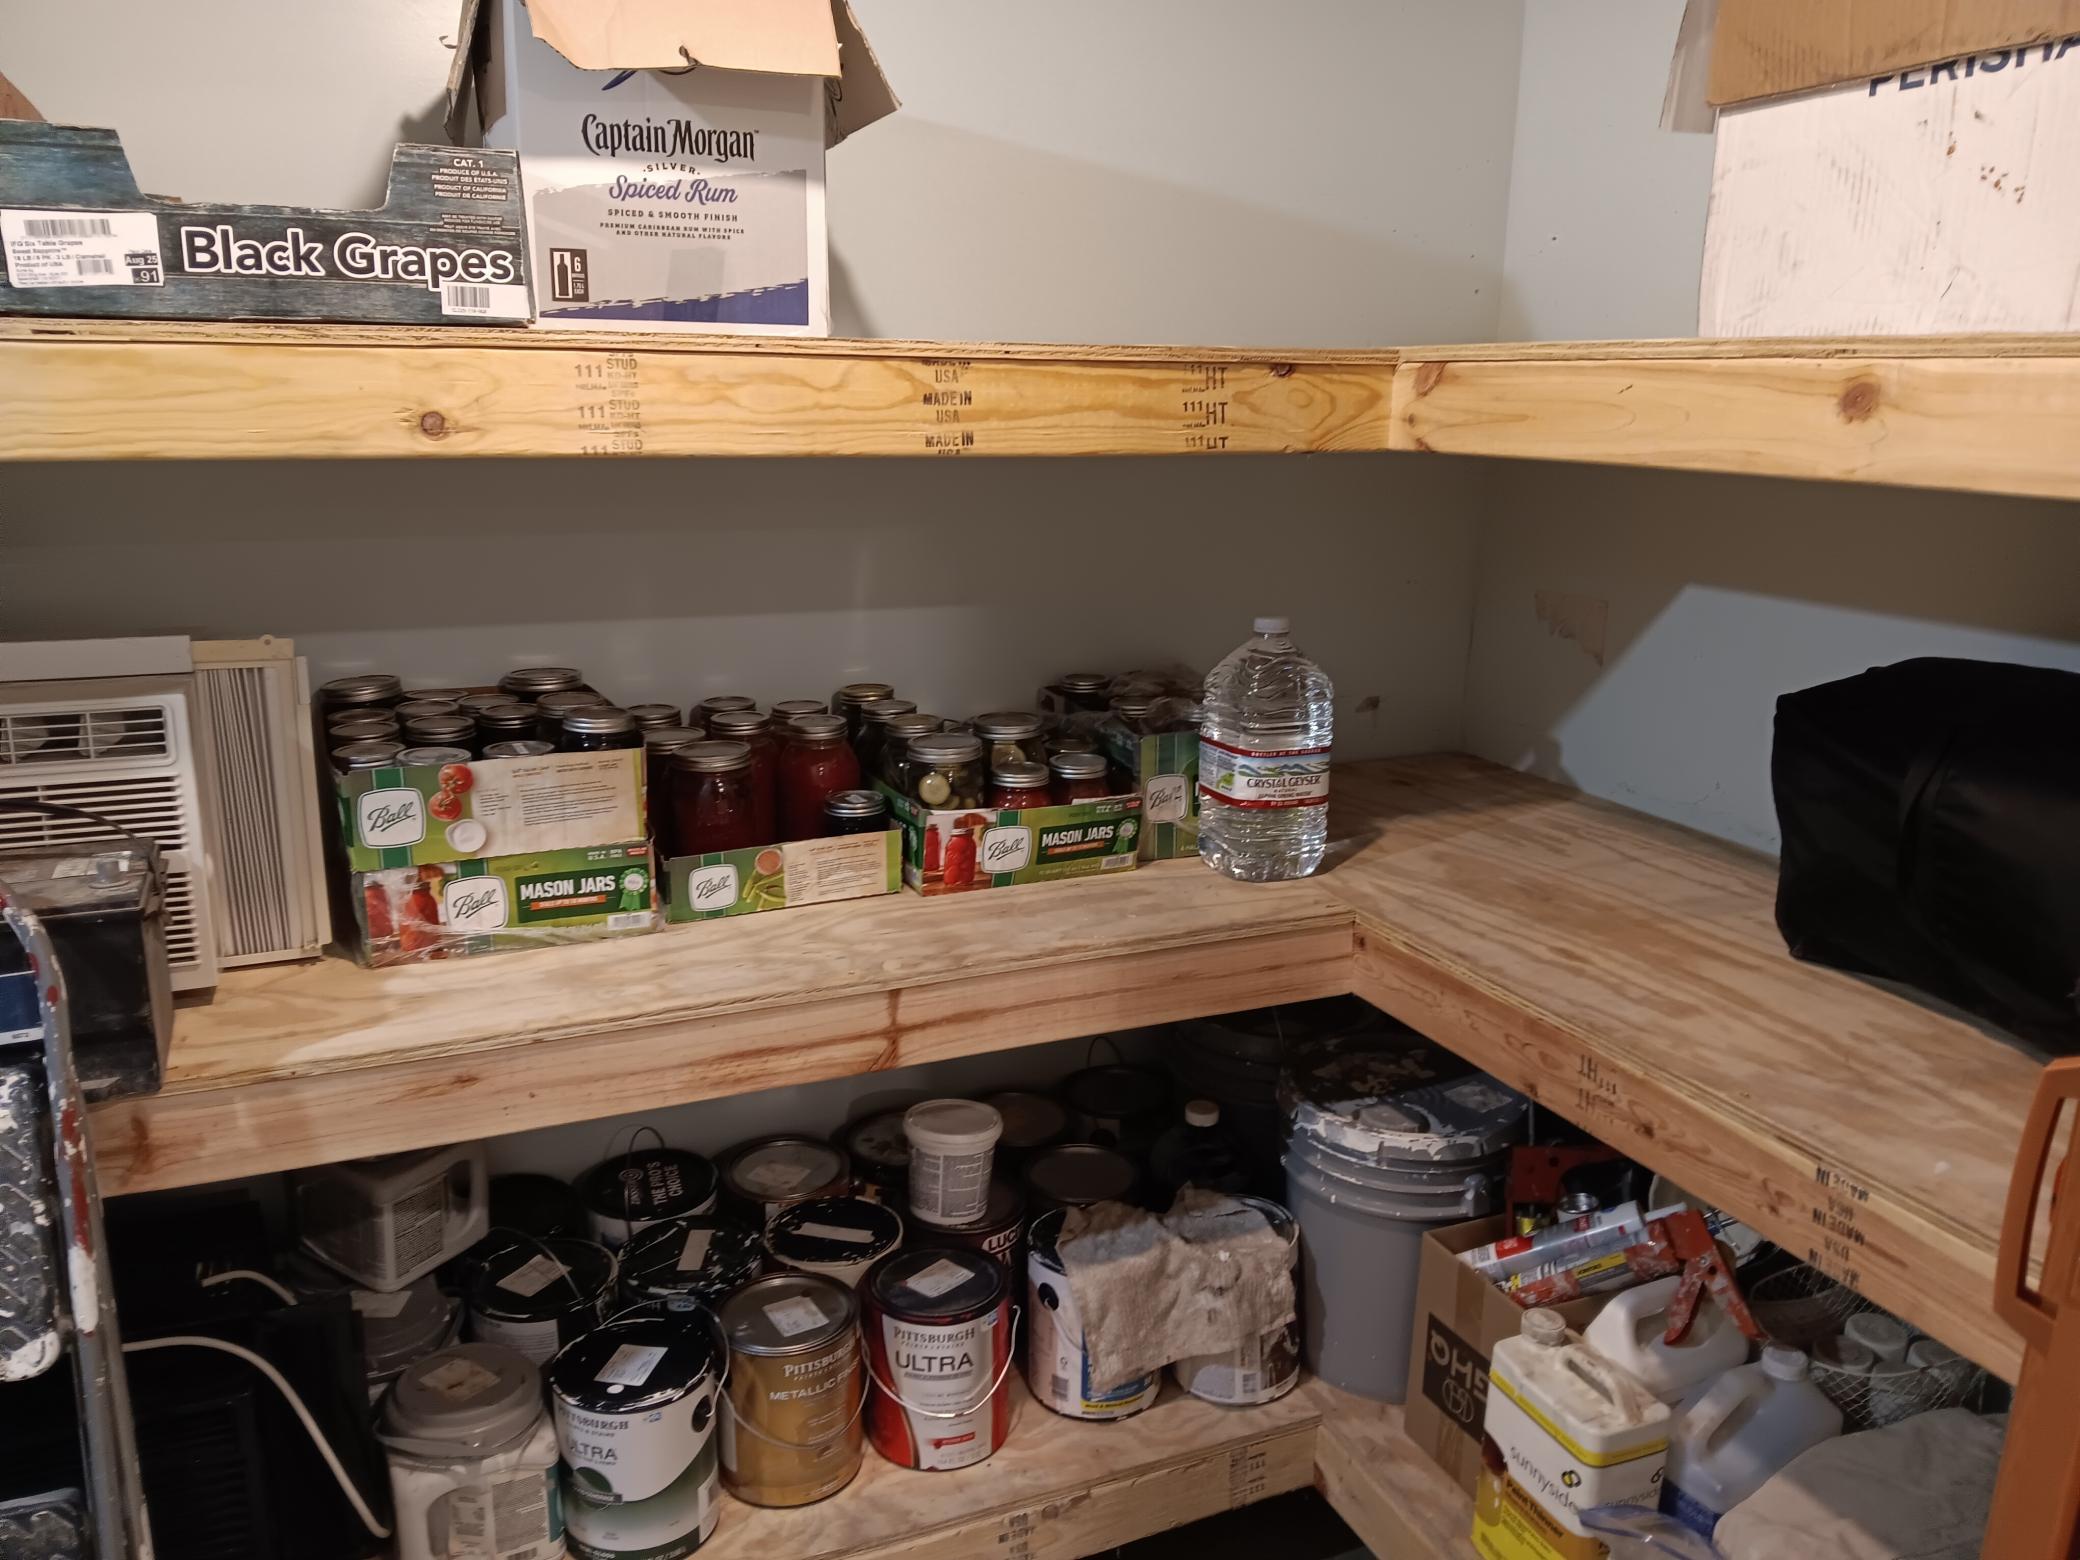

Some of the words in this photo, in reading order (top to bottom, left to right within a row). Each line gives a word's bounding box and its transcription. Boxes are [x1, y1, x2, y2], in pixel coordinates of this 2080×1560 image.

[581, 113, 668, 157] Captain
[666, 119, 755, 162] Morgan
[453, 158, 476, 168] CAT.
[478, 160, 485, 168] 1
[646, 162, 697, 175] SILVER
[431, 174, 460, 182] PRODUIT
[440, 168, 470, 176] PRODUCE
[472, 186, 507, 194] CALIFORNIA
[609, 175, 683, 202] Spiced
[685, 178, 738, 206] Rum
[607, 208, 644, 218] SPICED
[648, 210, 655, 218] &
[658, 211, 700, 220] SMOOTH
[704, 213, 738, 222] FINISH
[600, 222, 636, 230] PREMIUM
[638, 224, 681, 232] CARIBBEAN
[662, 232, 696, 240] NATURAL
[126, 255, 145, 266] Aug
[147, 255, 158, 264] 25
[181, 225, 325, 276] Black
[334, 232, 514, 291] Grapes
[574, 256, 582, 272] 6
[140, 269, 158, 283] 91
[575, 363, 602, 378] 111
[606, 358, 637, 370] STUD
[935, 368, 959, 384] USA
[1206, 366, 1229, 391] HT
[608, 399, 640, 410] STUD
[923, 391, 957, 406] MADE
[960, 390, 972, 406] IN
[1182, 400, 1203, 412] 111
[578, 405, 605, 418] 111
[936, 409, 960, 423] USA
[1206, 402, 1229, 425] HT
[612, 439, 643, 450] STUD
[925, 433, 960, 448] MADE
[962, 431, 974, 446] IN
[1246, 776, 1287, 788] CRYSTAL
[1288, 775, 1321, 786] GEYSER
[367, 800, 416, 832] Ball
[1041, 829, 1082, 848] MASON
[1084, 826, 1114, 841] JARS
[988, 837, 1025, 861] Ball
[520, 878, 574, 901] MASON
[577, 875, 616, 894] JARS
[696, 875, 731, 899] Ball
[452, 888, 499, 918] Ball
[663, 1163, 684, 1198] CHOICE
[650, 1186, 670, 1206] THE
[1813, 1207, 1827, 1227] IN
[1828, 1214, 1864, 1245] MADE
[1824, 1236, 1850, 1261] USA
[893, 1326, 975, 1345] PITTSBURGH
[895, 1350, 974, 1373] ULTRA
[769, 1377, 837, 1402] METALLIC
[1510, 1446, 1578, 1517] sunnyside
[1505, 1478, 1529, 1504] Paint
[1529, 1501, 1565, 1539] Thinner
